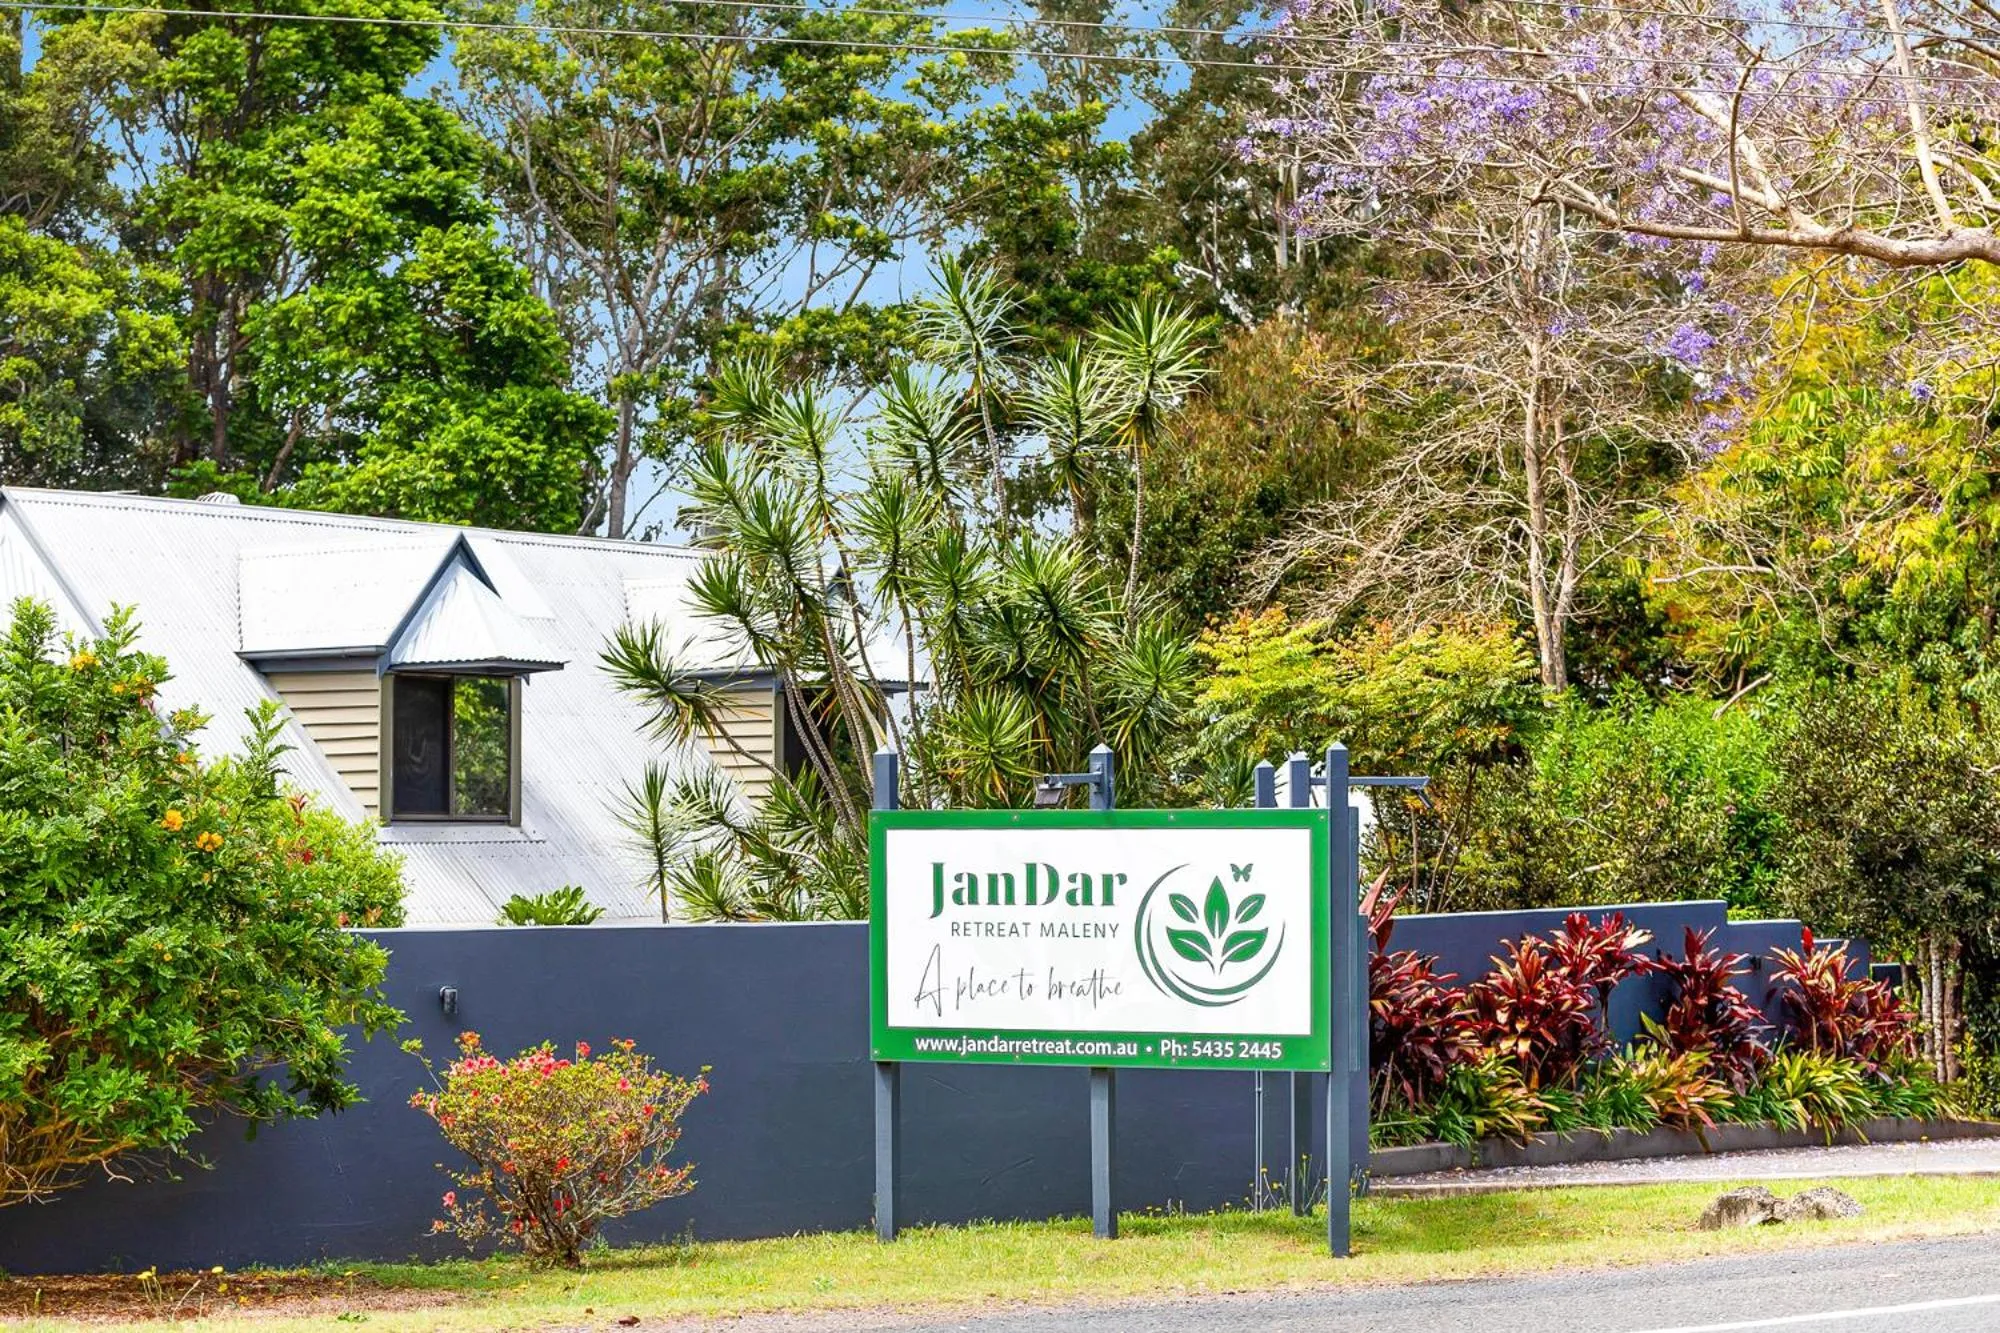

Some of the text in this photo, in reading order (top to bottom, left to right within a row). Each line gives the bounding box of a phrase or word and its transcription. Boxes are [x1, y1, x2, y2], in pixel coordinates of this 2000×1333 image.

[929, 862, 1128, 919] JanDar
[951, 921, 1120, 939] RETREAT MALENY
[913, 943, 1123, 1018] A place to breathe
[915, 1036, 1283, 1059] www.jandarretreat.com.au Ph: 5435 2445
